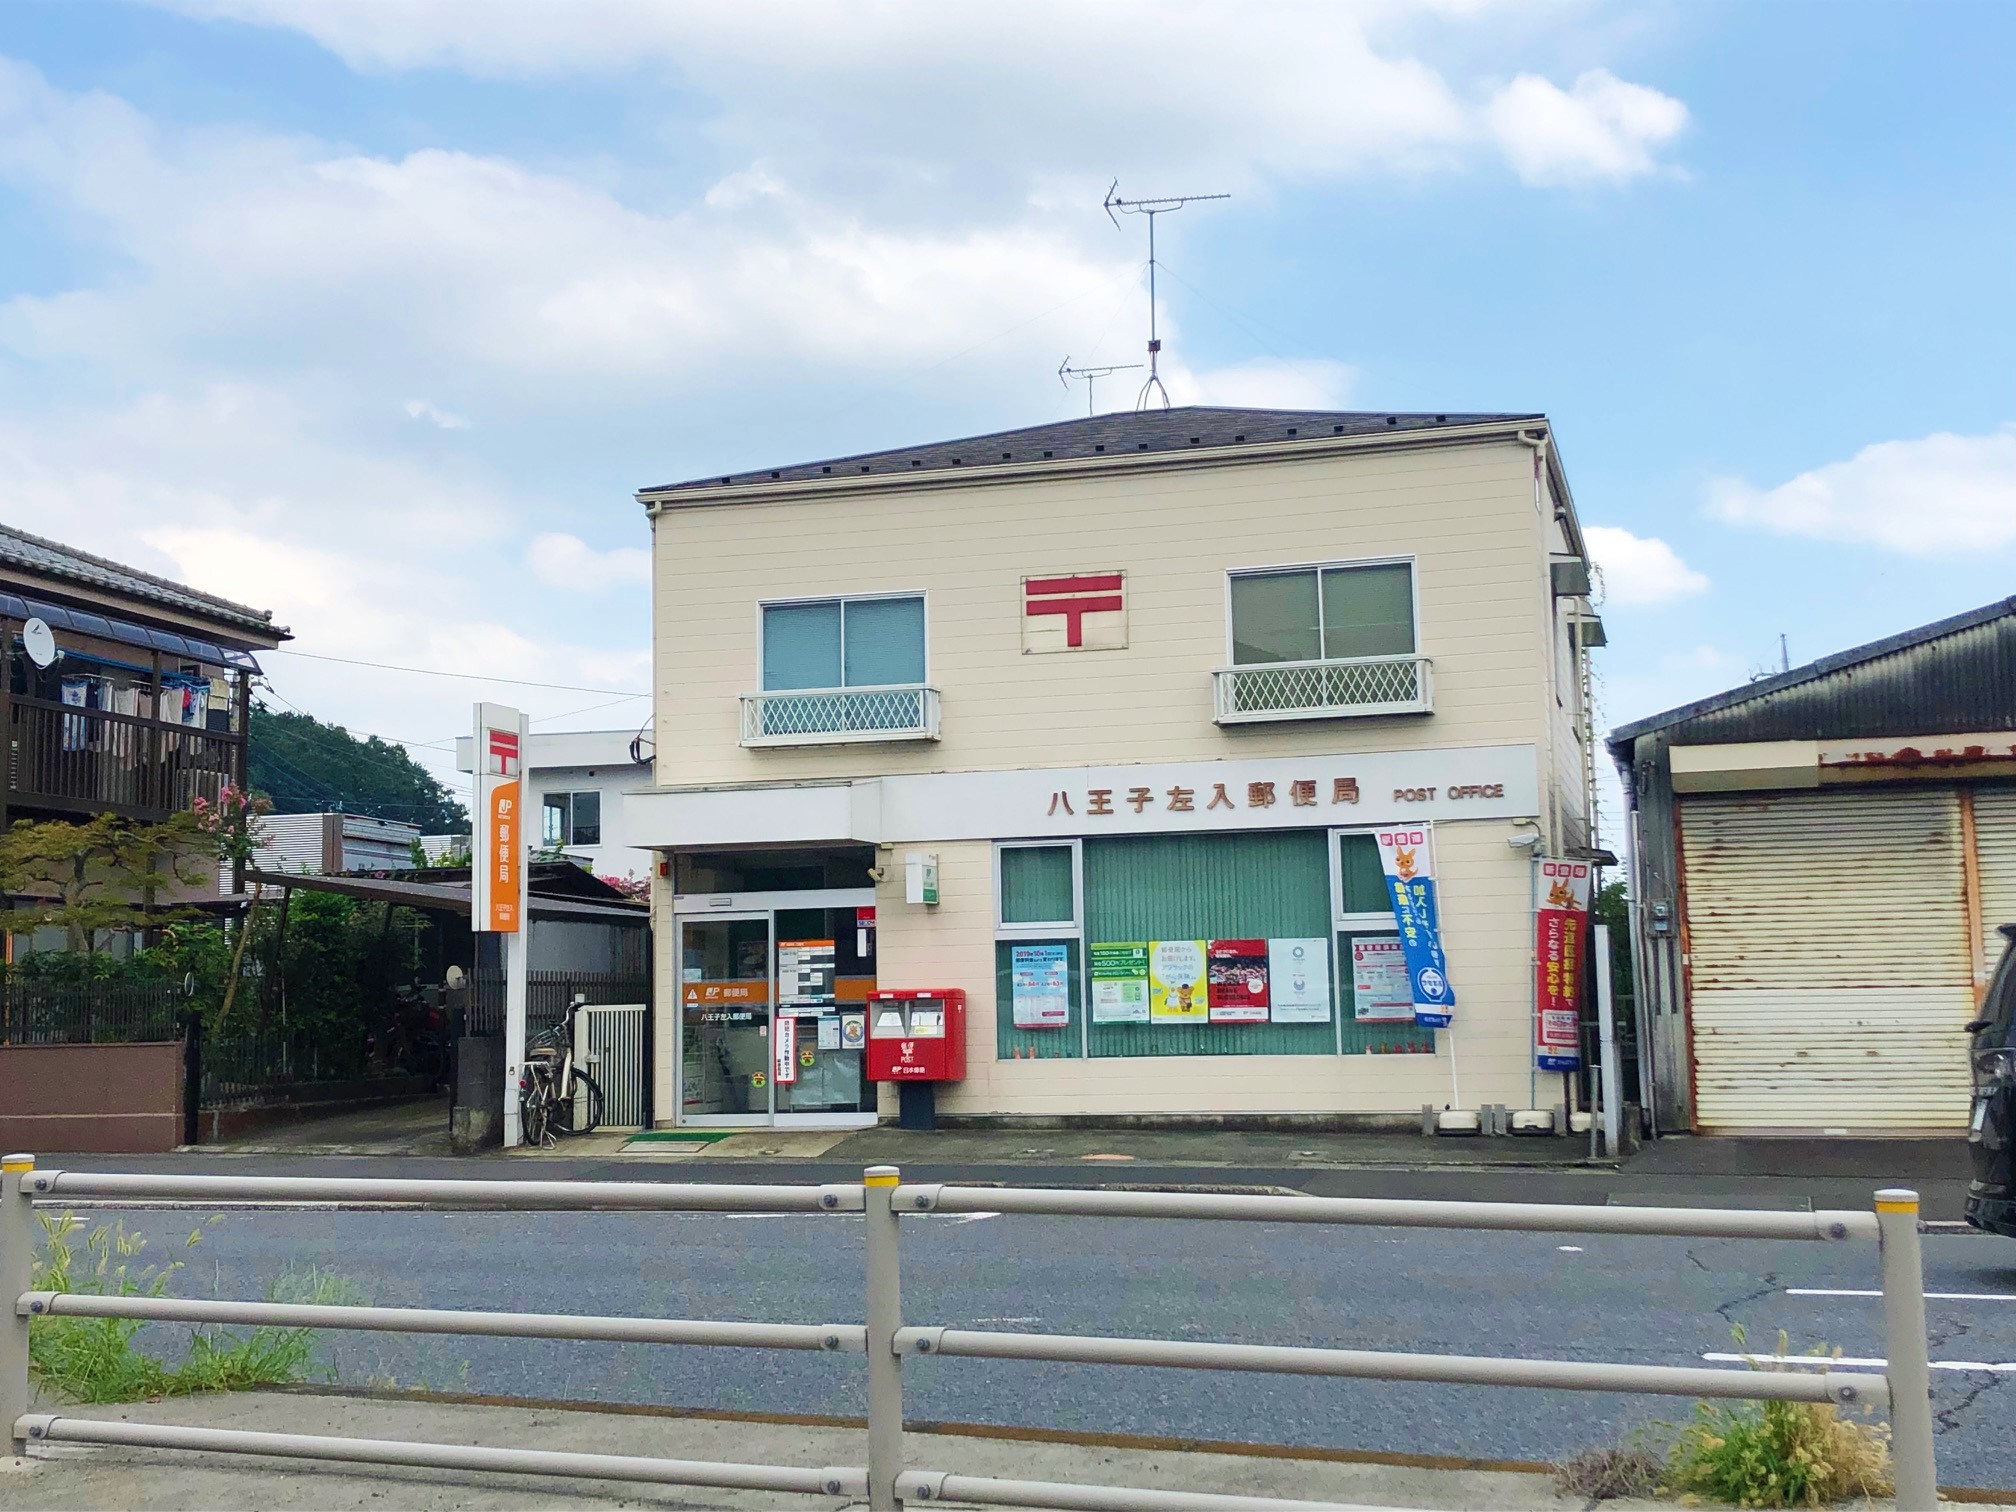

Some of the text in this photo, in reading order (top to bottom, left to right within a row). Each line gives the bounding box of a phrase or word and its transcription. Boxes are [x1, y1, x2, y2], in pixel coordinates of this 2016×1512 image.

[1047, 777, 1504, 816] 八王子左入郵便局 POST OFFICE
[499, 824, 509, 884] 郵便局
[723, 988, 748, 998] 郵便局
[701, 1012, 752, 1021] 八王子左入郵便局
